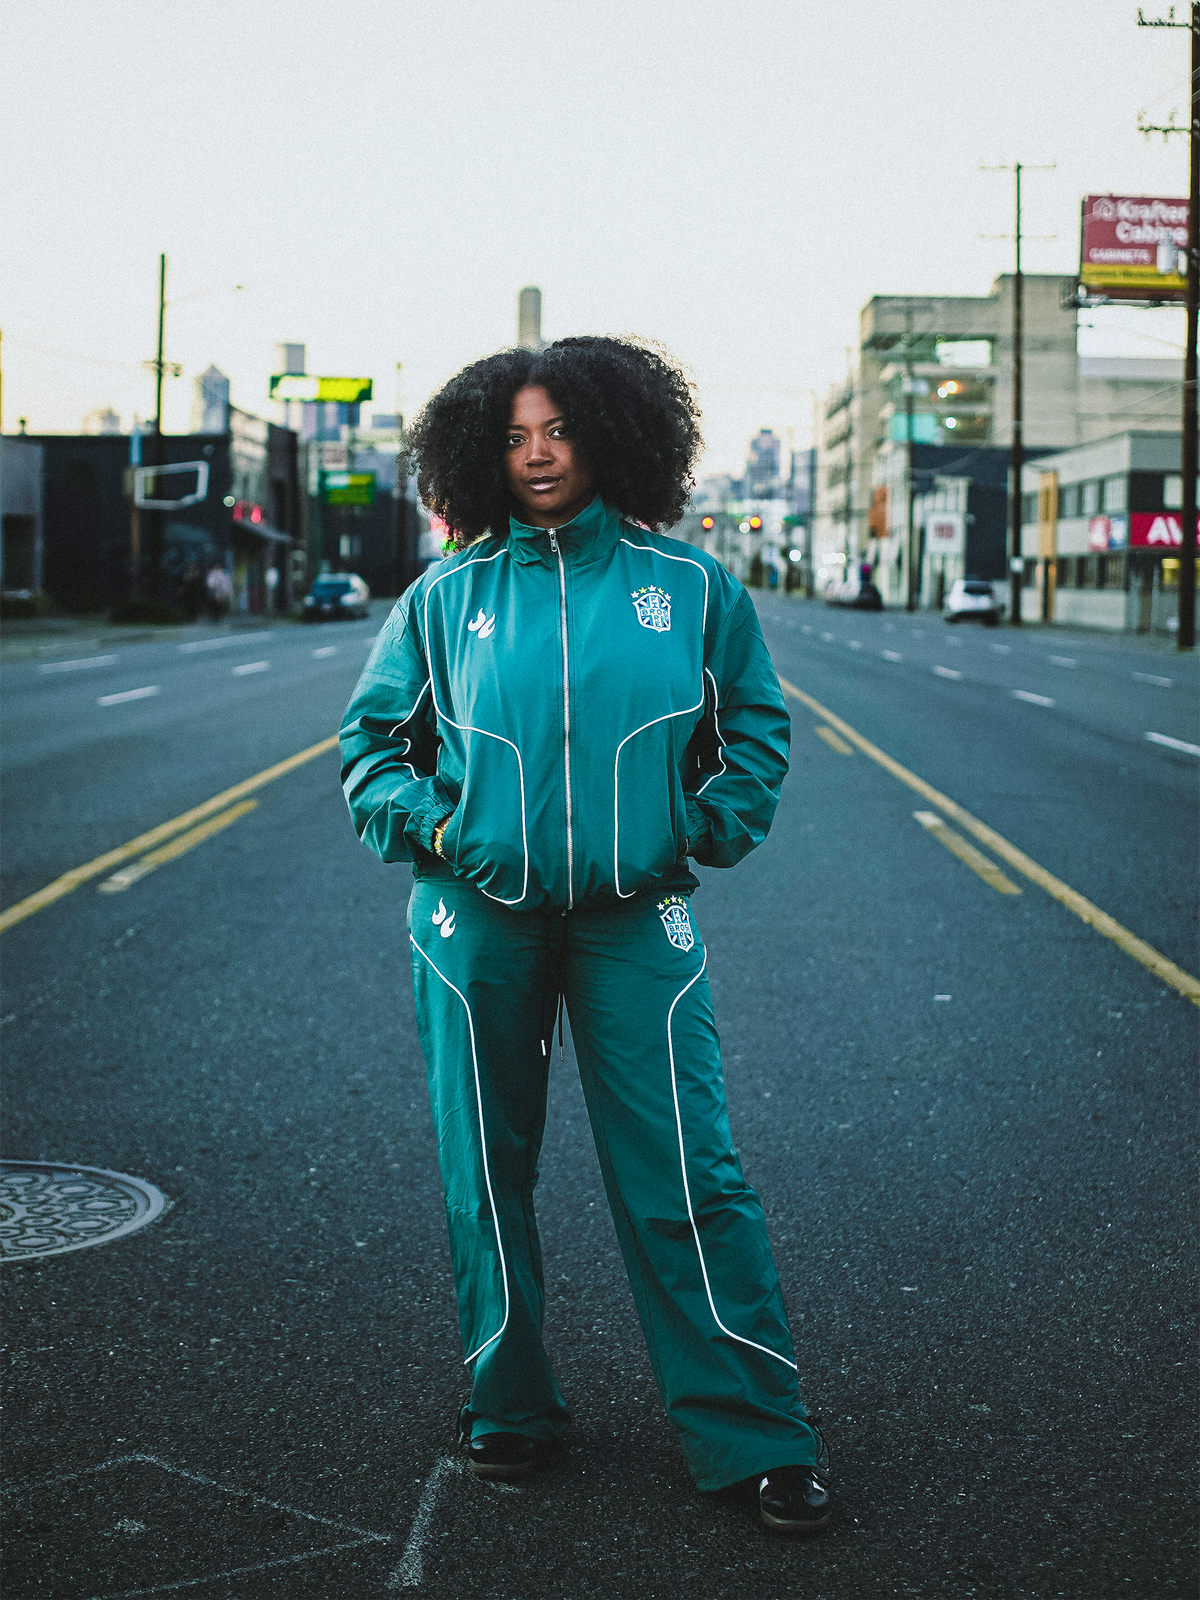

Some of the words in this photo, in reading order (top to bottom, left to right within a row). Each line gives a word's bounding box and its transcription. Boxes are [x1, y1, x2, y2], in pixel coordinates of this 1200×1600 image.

[1089, 247, 1151, 264] CABINETS
[1147, 516, 1200, 545] AV
[642, 609, 668, 618] BROS
[669, 924, 689, 932] BROS
